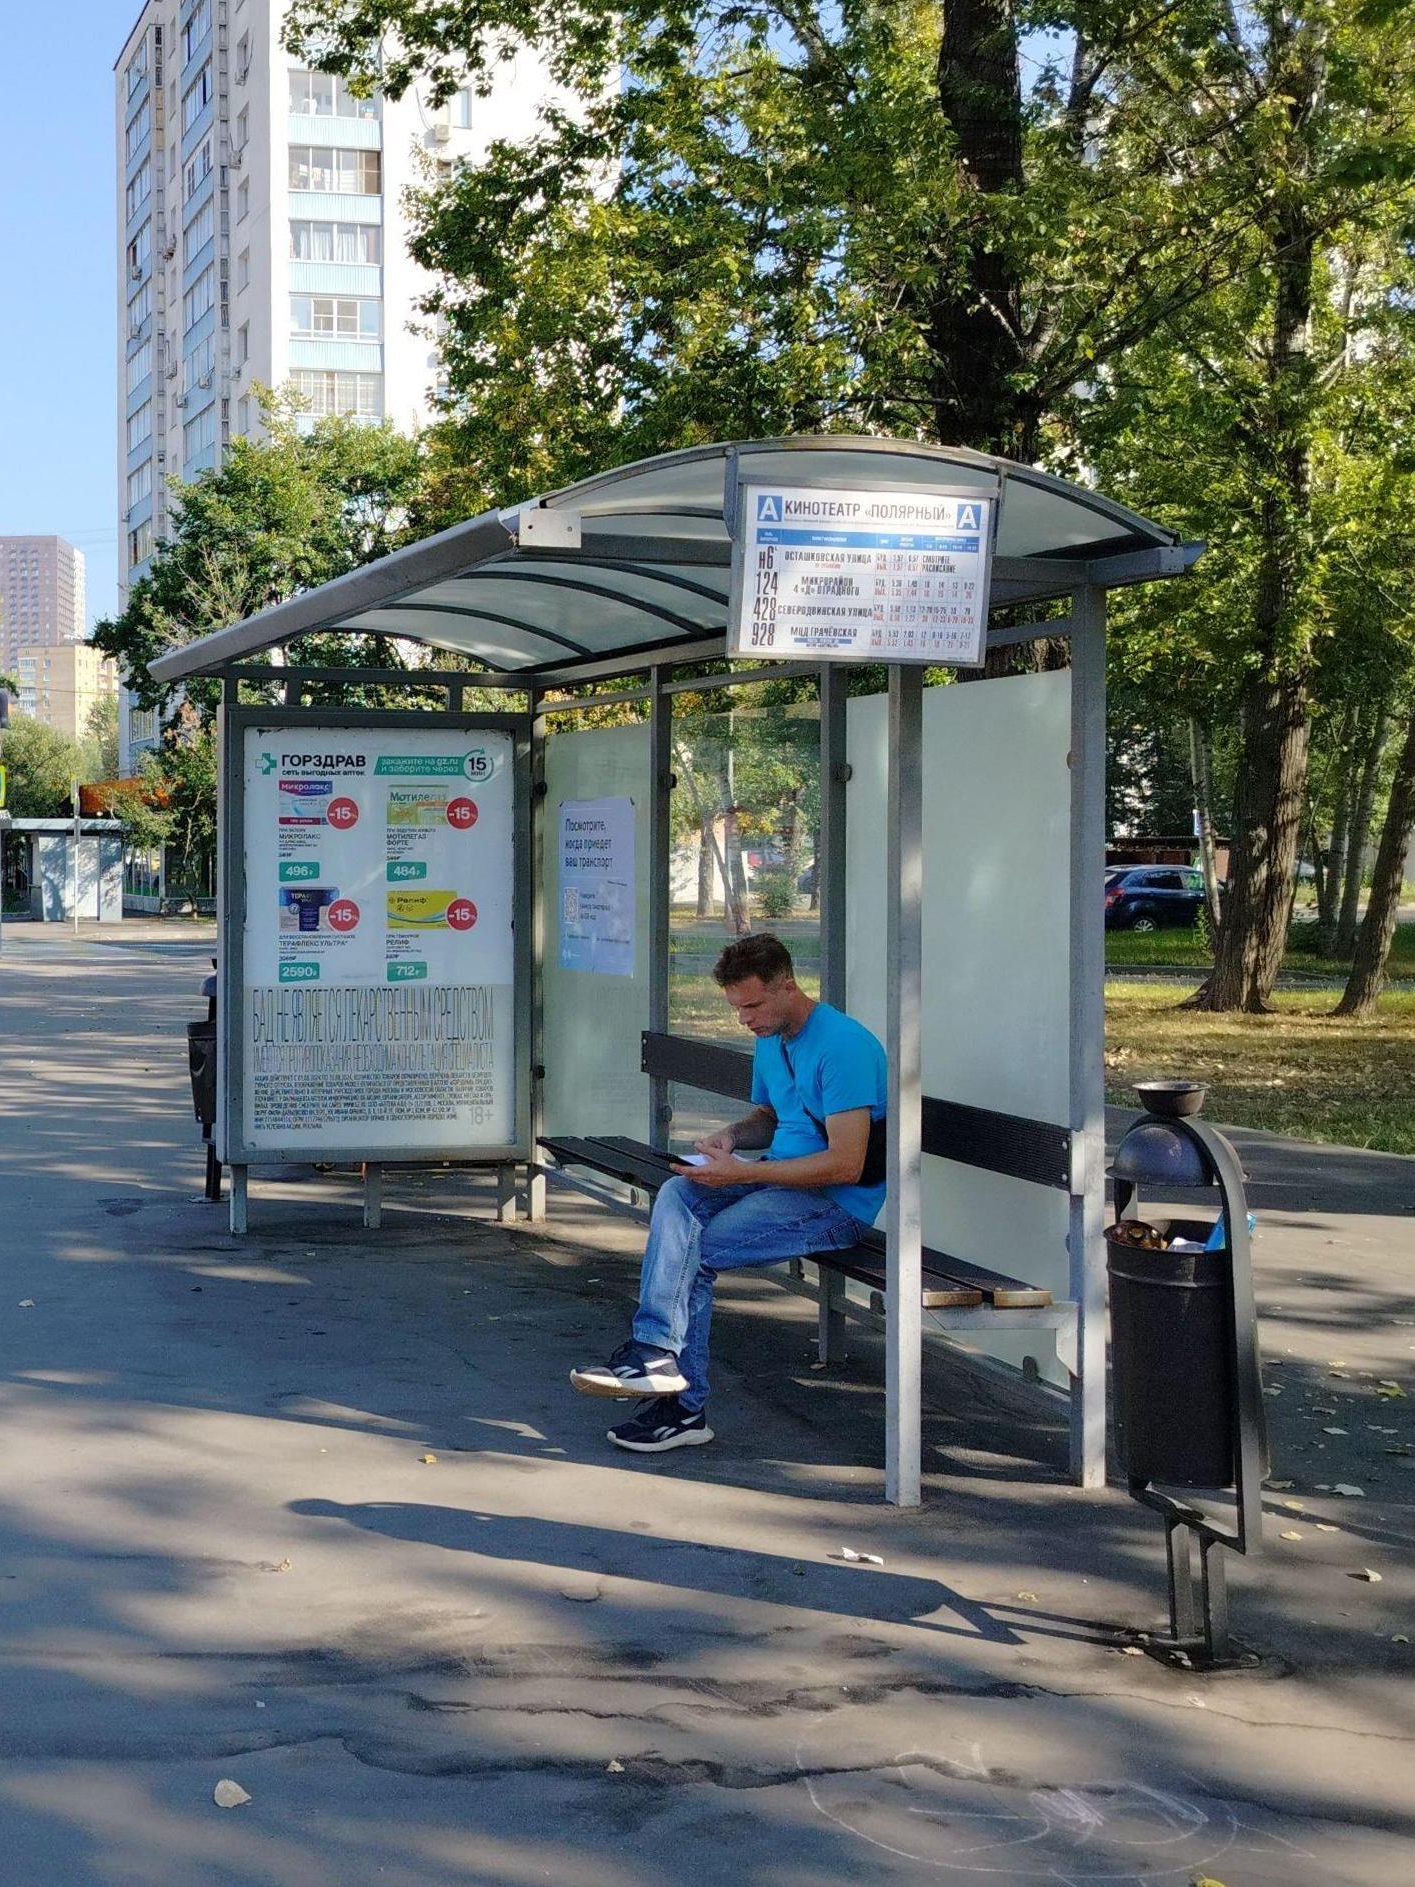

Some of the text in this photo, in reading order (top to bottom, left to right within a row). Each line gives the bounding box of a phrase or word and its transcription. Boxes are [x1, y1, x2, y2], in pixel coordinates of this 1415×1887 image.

[785, 500, 860, 516] КИНОТЕАТР
[865, 503, 951, 520] «ПОЛЯРНЫЙ»
[757, 572, 778, 595] 124
[753, 597, 777, 621] 428
[752, 623, 775, 646] 928
[282, 754, 366, 769] ГОРЗДРАВ
[469, 757, 486, 771] 15
[469, 1105, 494, 1125] 18+
